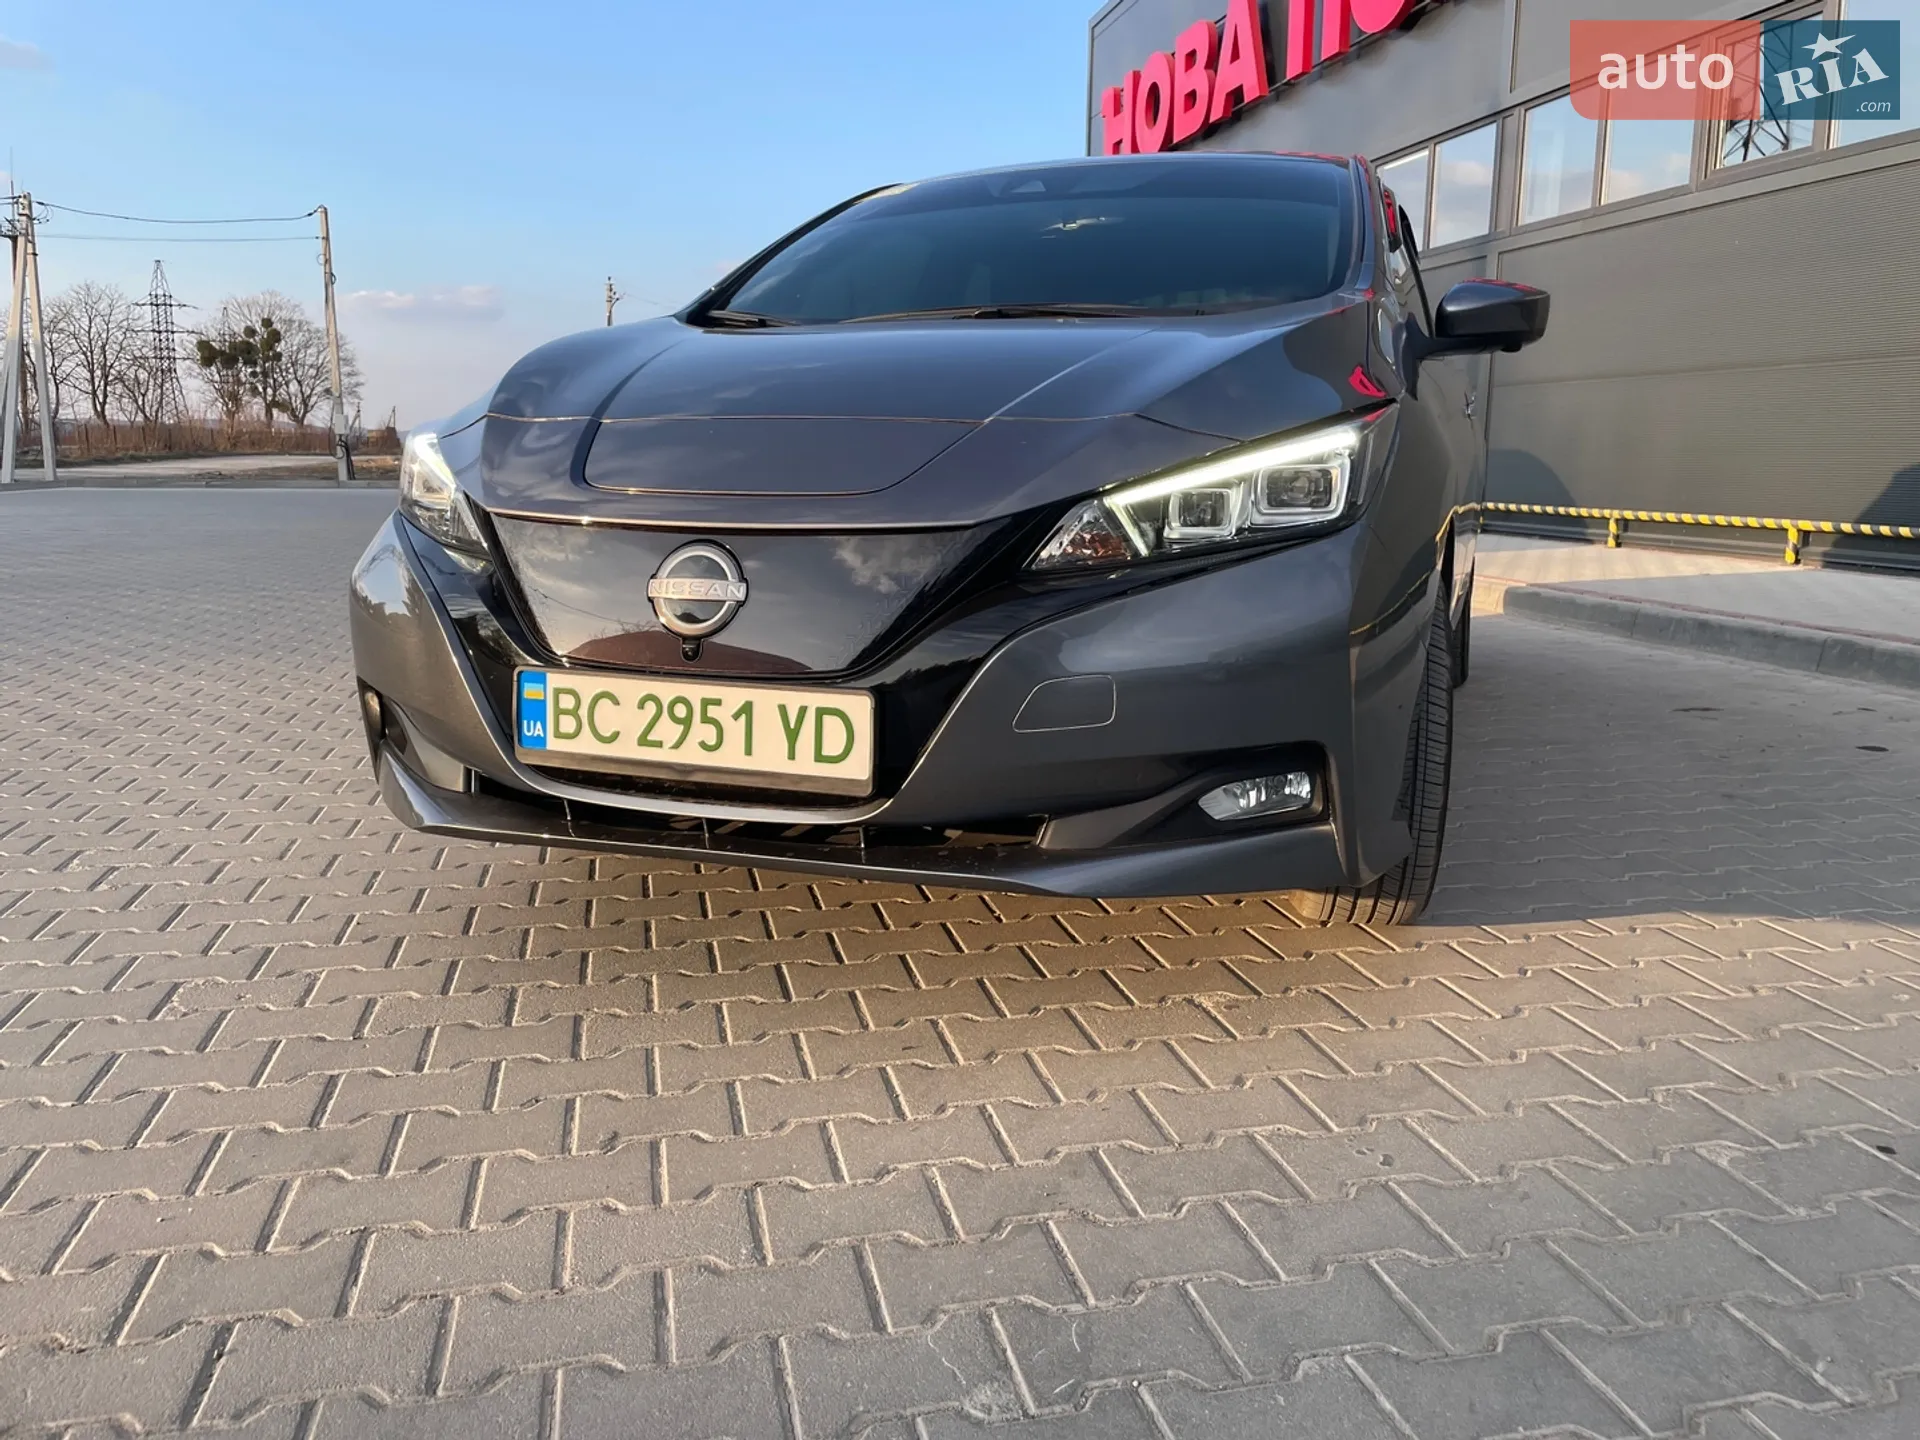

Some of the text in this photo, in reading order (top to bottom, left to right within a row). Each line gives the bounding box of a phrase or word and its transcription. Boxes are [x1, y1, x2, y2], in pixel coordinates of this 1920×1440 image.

[1101, 0, 1268, 155] НОВА
[649, 580, 744, 599] NISSAN
[523, 719, 544, 738] UA
[552, 687, 855, 764] BC 2951 YD
